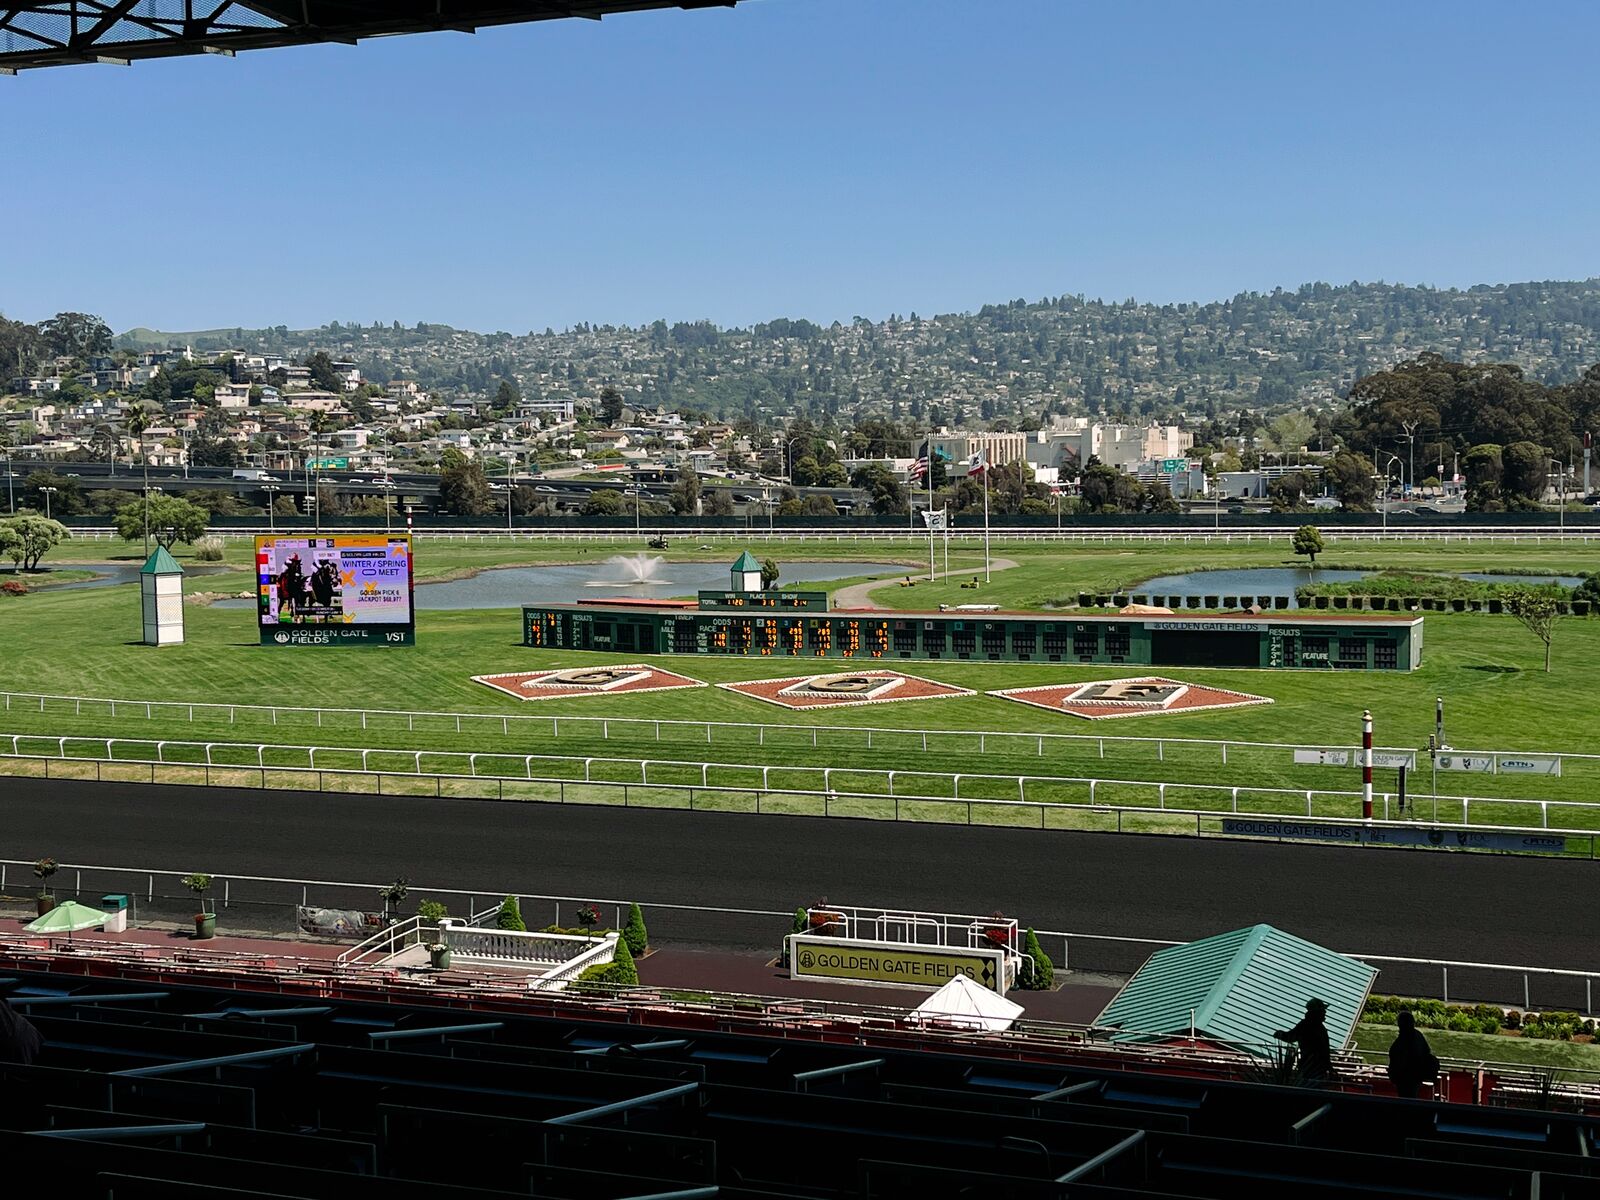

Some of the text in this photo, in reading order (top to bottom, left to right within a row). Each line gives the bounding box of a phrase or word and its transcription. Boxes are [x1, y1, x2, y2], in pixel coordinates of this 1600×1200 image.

[342, 560, 371, 568] WINTER
[378, 559, 407, 568] SPRING
[572, 614, 593, 622] RESULTS
[1162, 622, 1259, 631] GOLDEN GATE FIELDS
[291, 629, 369, 637] GOLDEN GATE
[1268, 628, 1301, 636] RESULTS
[291, 636, 330, 644] FIELDS
[1302, 652, 1329, 660] FEATURE
[1235, 823, 1351, 838] GOLDEN GATE FIELDS
[818, 954, 975, 980] GOLDEN GATE FIELDS
